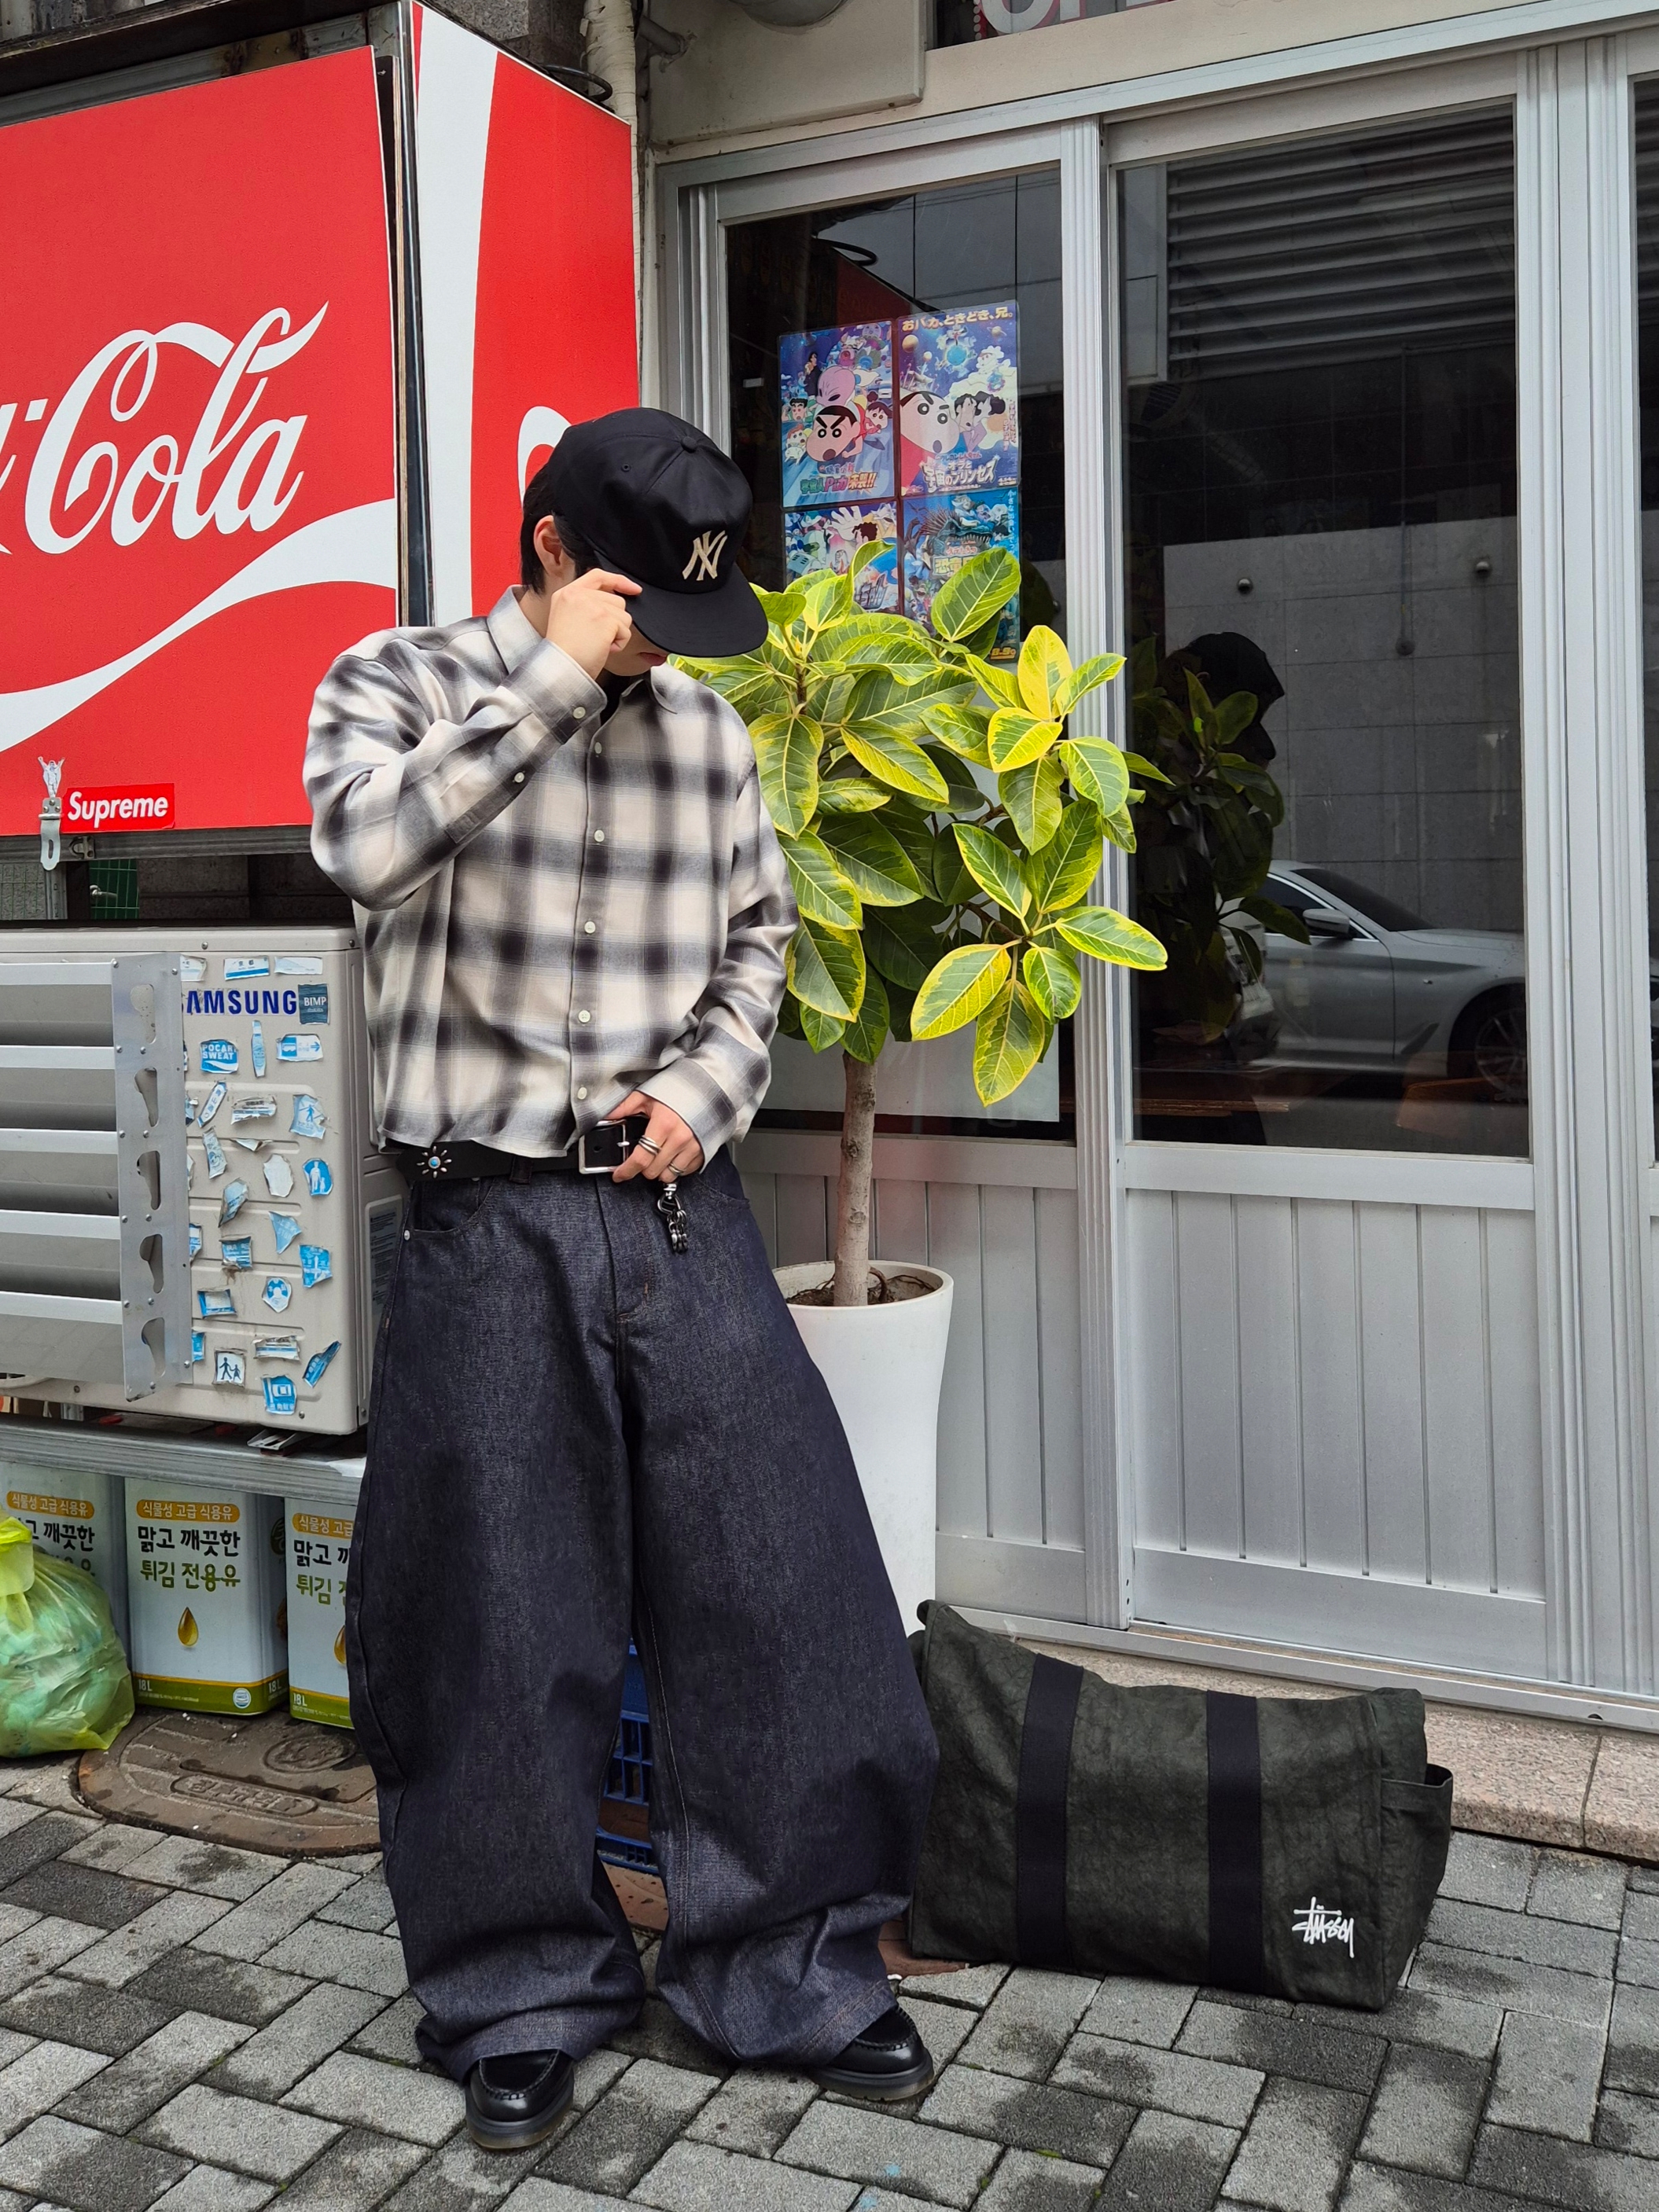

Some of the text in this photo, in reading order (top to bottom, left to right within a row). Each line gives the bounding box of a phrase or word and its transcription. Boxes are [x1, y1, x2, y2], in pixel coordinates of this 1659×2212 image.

[682, 530, 728, 581] NY
[68, 791, 169, 829] Supreme
[182, 990, 297, 1015] AMSUNG
[202, 1051, 234, 1060] SWEAT
[12, 1493, 88, 1516] 식물성 고급 식용유
[142, 1501, 234, 1521] 식물성 고급 식용유
[43, 1522, 95, 1552] 깨끗한
[299, 1515, 329, 1534] 식물성
[137, 1526, 175, 1552] 맑고
[180, 1529, 241, 1557] 깨끗한
[293, 1539, 332, 1567] 맑고
[140, 1560, 241, 1593] 튀김 전용유
[296, 1574, 332, 1605] 튀김
[292, 1693, 307, 1707] 18L
